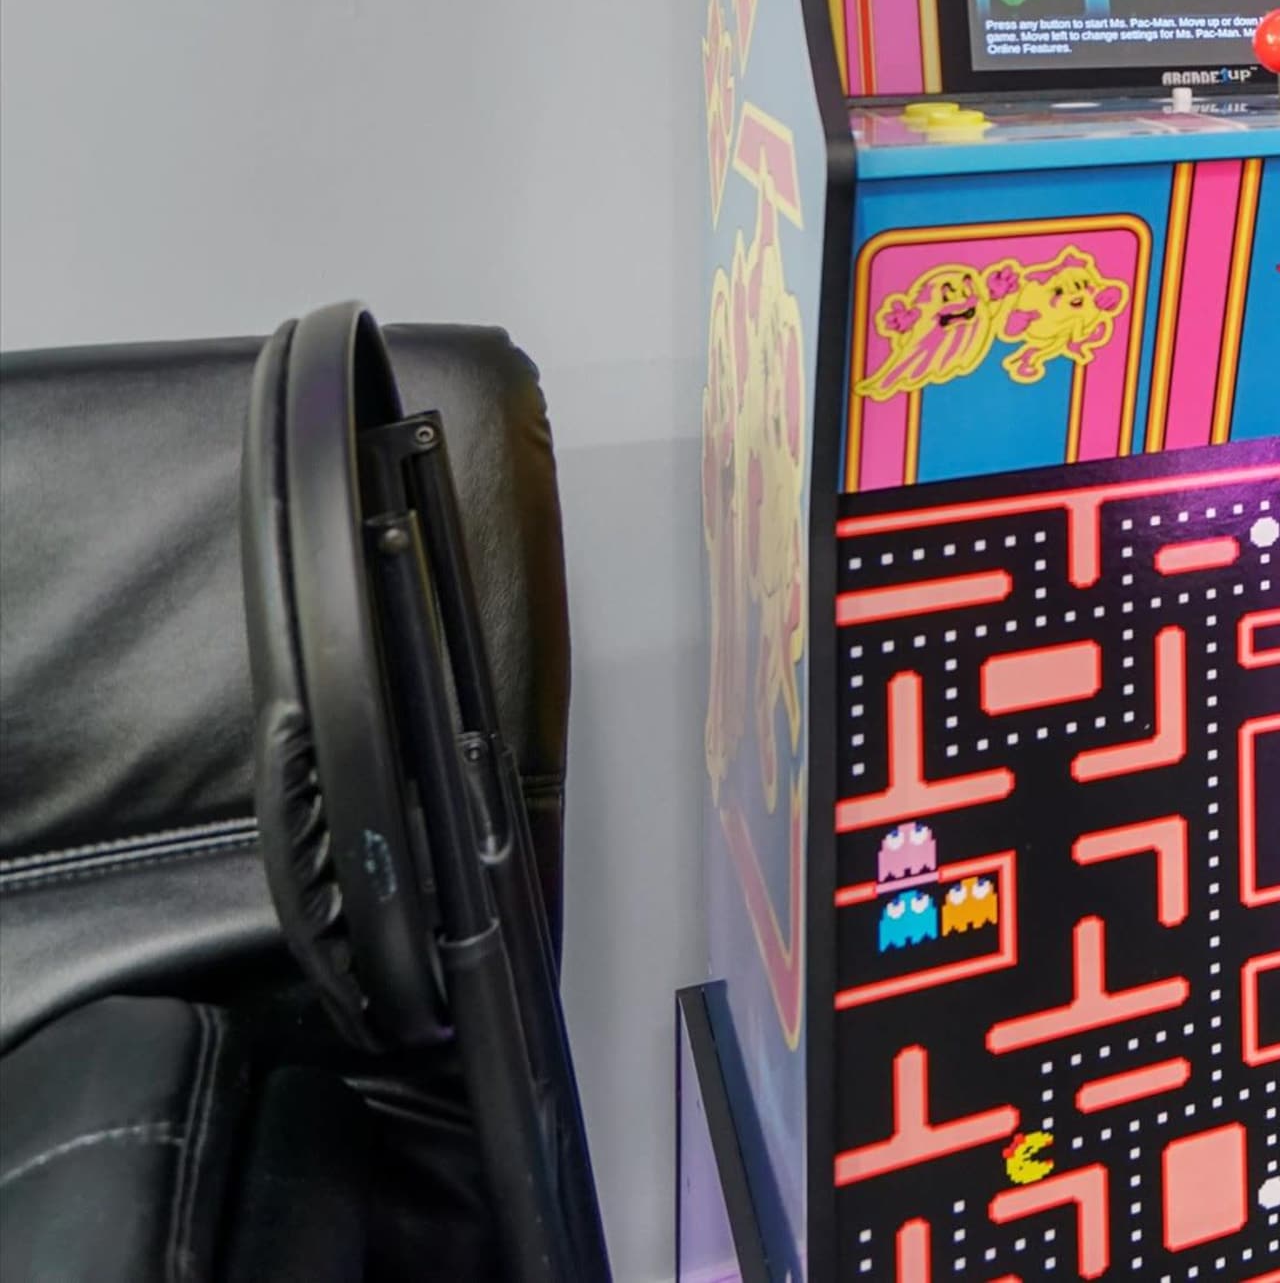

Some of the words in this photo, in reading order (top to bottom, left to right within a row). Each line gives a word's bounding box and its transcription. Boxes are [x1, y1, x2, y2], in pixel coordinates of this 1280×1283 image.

[986, 20, 1016, 30] Press
[1020, 21, 1038, 32] any
[1040, 19, 1071, 29] button
[1072, 20, 1083, 29] to
[1085, 19, 1107, 29] start
[1110, 19, 1128, 28] Ms.
[1130, 18, 1177, 28] Pac-Man.
[1179, 18, 1205, 27] Move
[1207, 18, 1219, 30] up
[1222, 18, 1231, 27] or
[1233, 16, 1258, 27] down
[986, 33, 1018, 44] game.
[1021, 32, 1049, 42] Move
[1051, 31, 1068, 41] left
[1069, 31, 1080, 41] to
[1081, 30, 1118, 43] change
[1120, 30, 1158, 42] settings
[1160, 30, 1174, 39] for
[1176, 29, 1193, 39] Ms.
[1195, 29, 1242, 39] Pac-Man.
[987, 44, 1021, 54] Online
[1022, 43, 1073, 54] Features.
